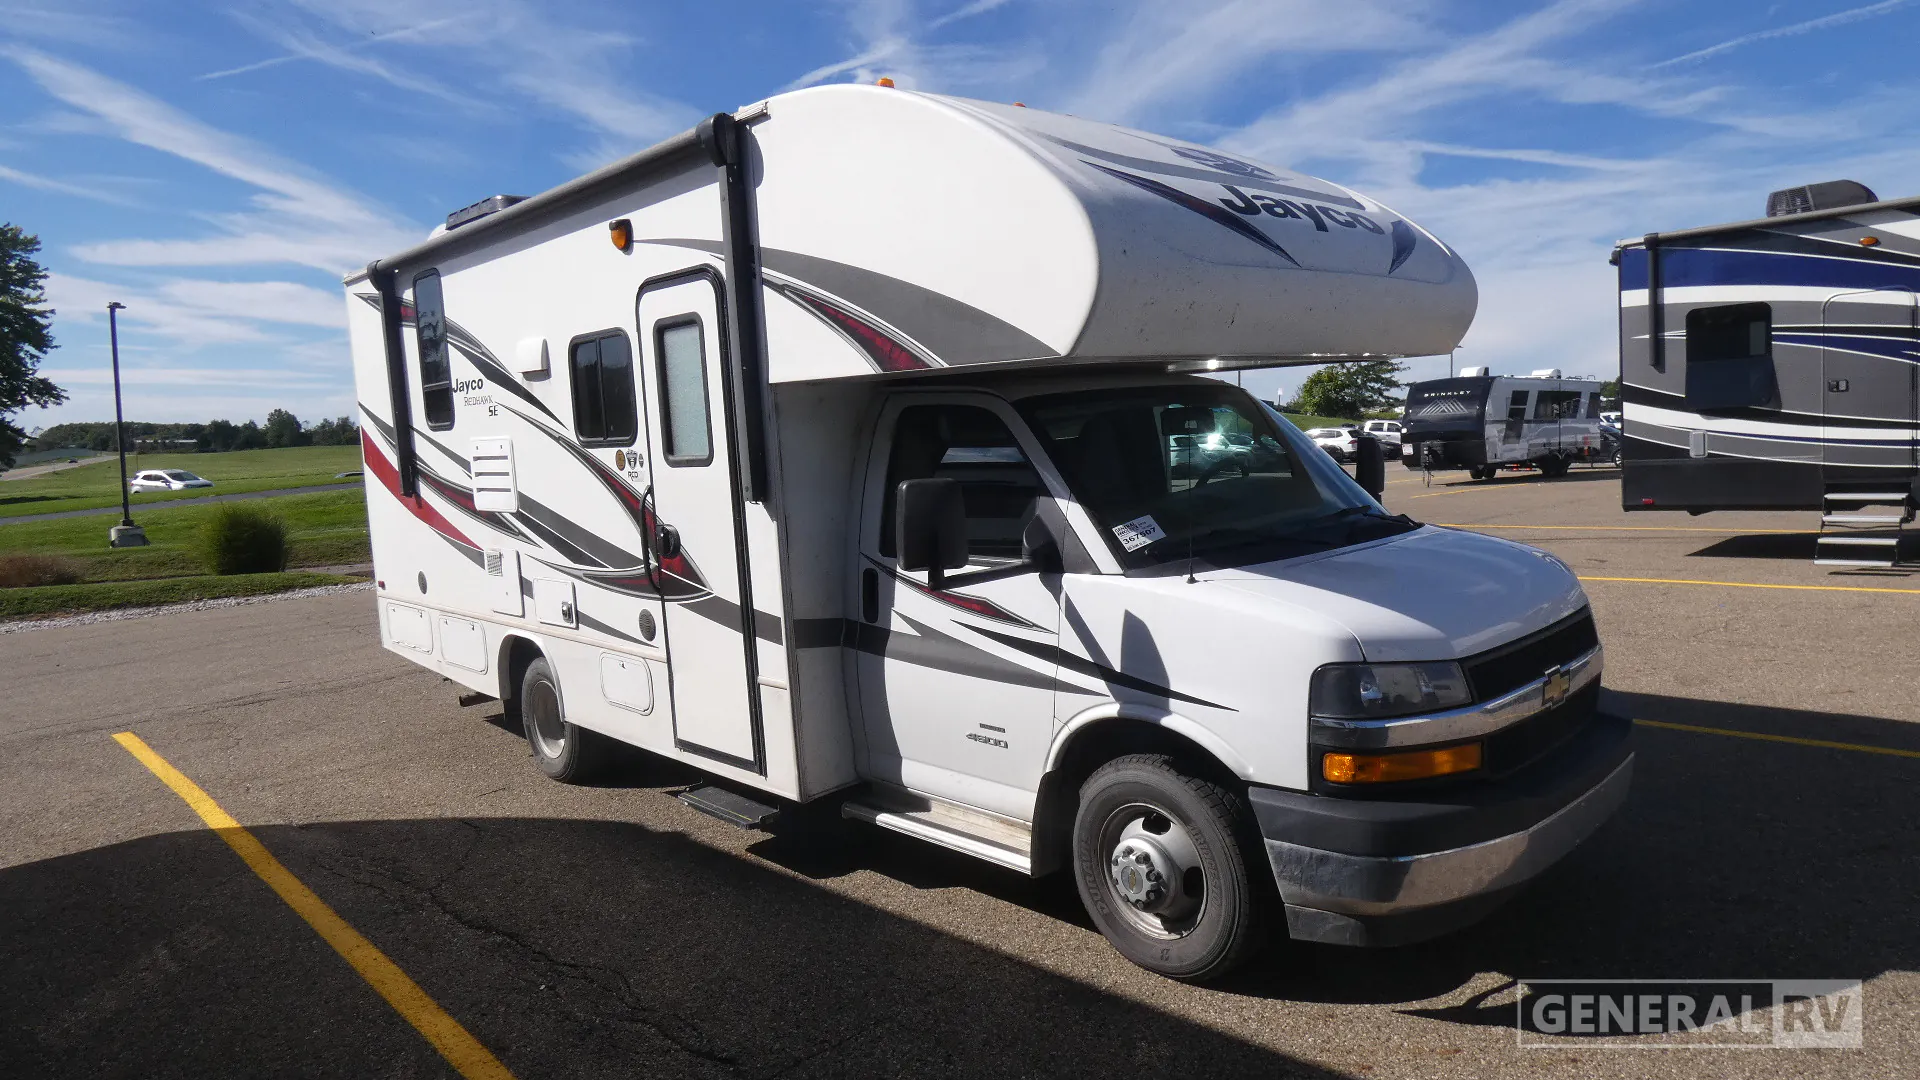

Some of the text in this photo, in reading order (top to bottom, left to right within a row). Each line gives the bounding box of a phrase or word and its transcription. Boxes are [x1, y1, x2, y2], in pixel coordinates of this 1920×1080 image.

[1218, 184, 1385, 235] Jayco
[452, 378, 484, 394] Jayco
[488, 405, 498, 417] SE
